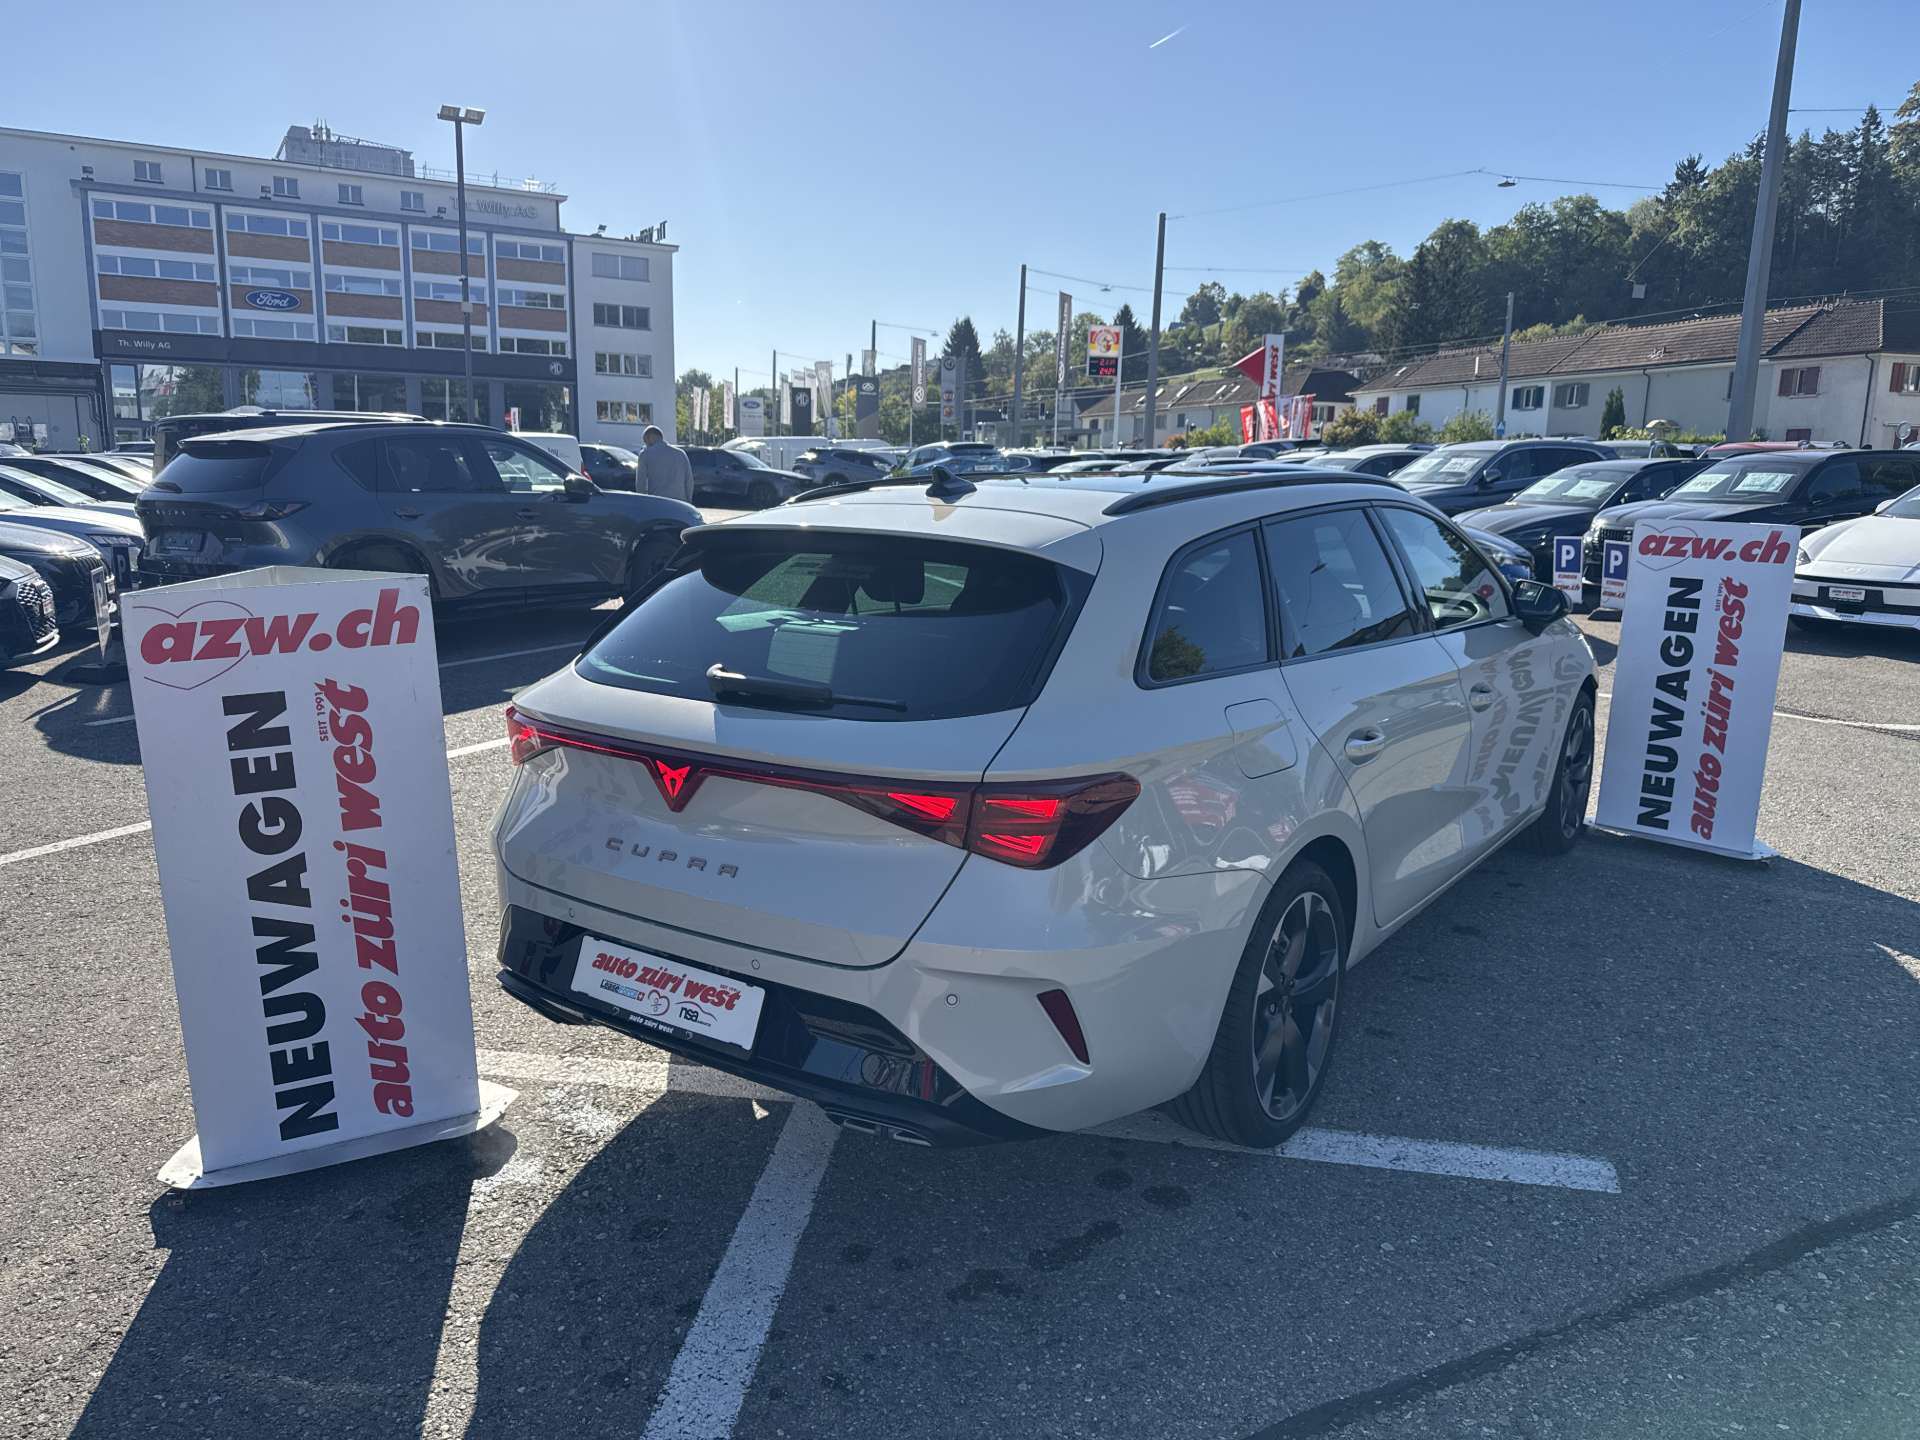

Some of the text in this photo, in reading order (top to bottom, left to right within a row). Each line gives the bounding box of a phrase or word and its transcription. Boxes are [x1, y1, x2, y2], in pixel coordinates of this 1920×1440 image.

[118, 339, 171, 350] Th. Willy AG
[1561, 544, 1575, 568] P
[1609, 549, 1623, 574] P
[1638, 530, 1792, 565] azw.ch
[140, 588, 421, 665] azw.ch
[314, 691, 330, 742] SEIT 1991
[1637, 576, 1704, 830] NEUWAGEN
[1690, 575, 1749, 841] auto züri west
[605, 837, 739, 879] CUPRA
[222, 690, 340, 1142] NEUWAGEN
[314, 678, 415, 1118] auto züri west
[591, 952, 743, 1011] auto züri west
[629, 1013, 643, 1024] auto
[679, 1007, 699, 1023] nsa
